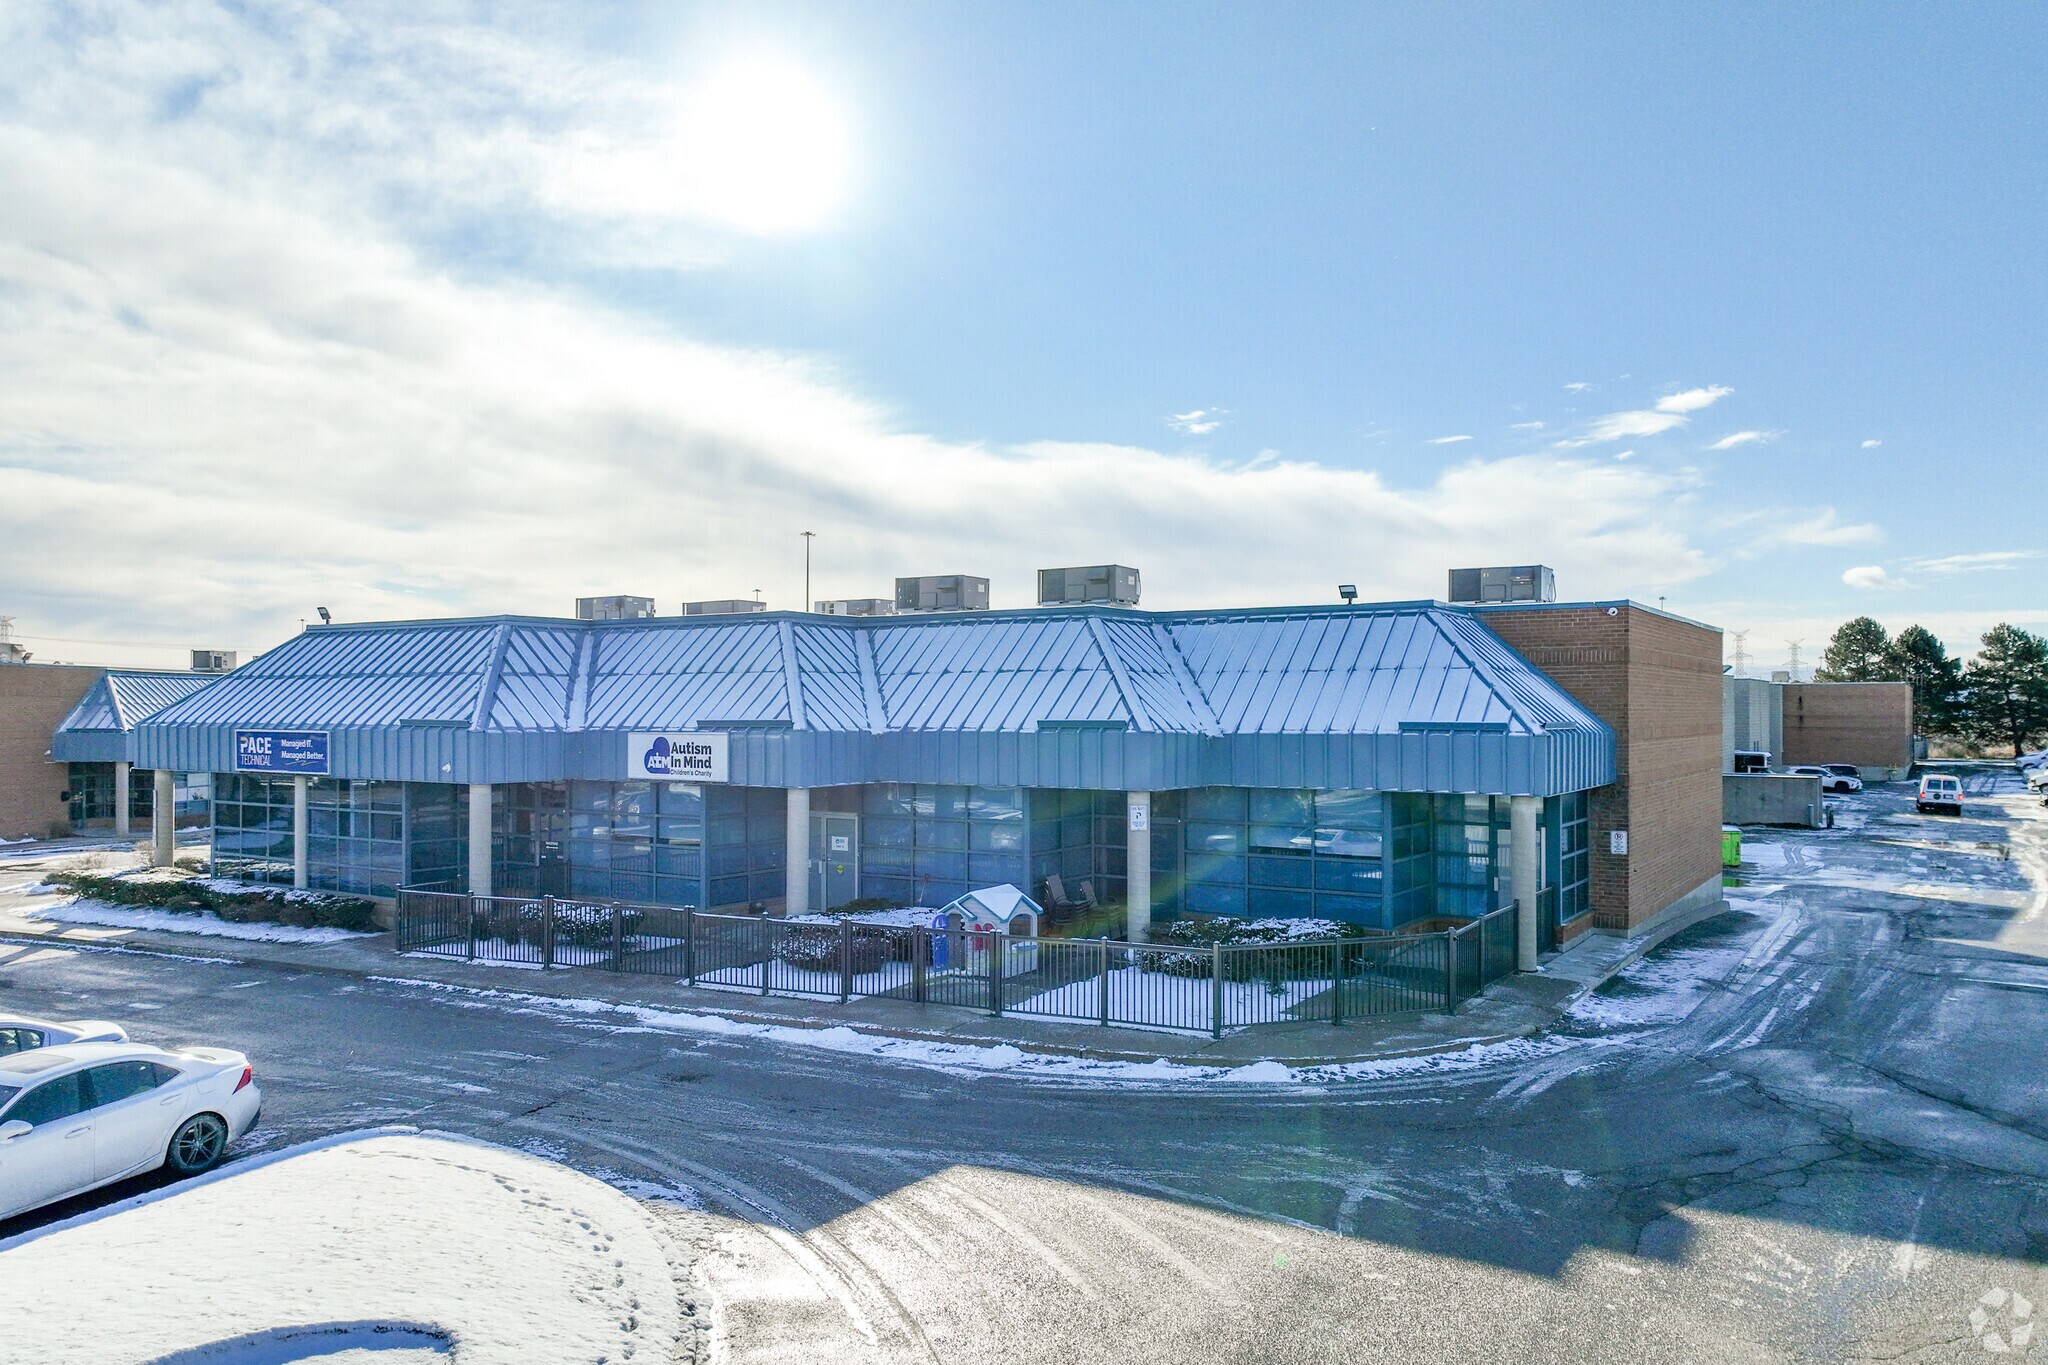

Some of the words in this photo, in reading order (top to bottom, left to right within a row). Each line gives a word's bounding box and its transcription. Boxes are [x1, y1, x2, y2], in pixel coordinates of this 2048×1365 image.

[240, 737, 272, 754] PACE
[281, 739, 306, 749] Managed
[671, 742, 712, 755] Autism
[240, 755, 272, 766] TECHNICAL
[281, 751, 306, 760] Managed
[306, 752, 325, 760] Better.
[671, 756, 681, 768] In
[683, 756, 712, 769] Mind
[694, 769, 713, 778] Charity
